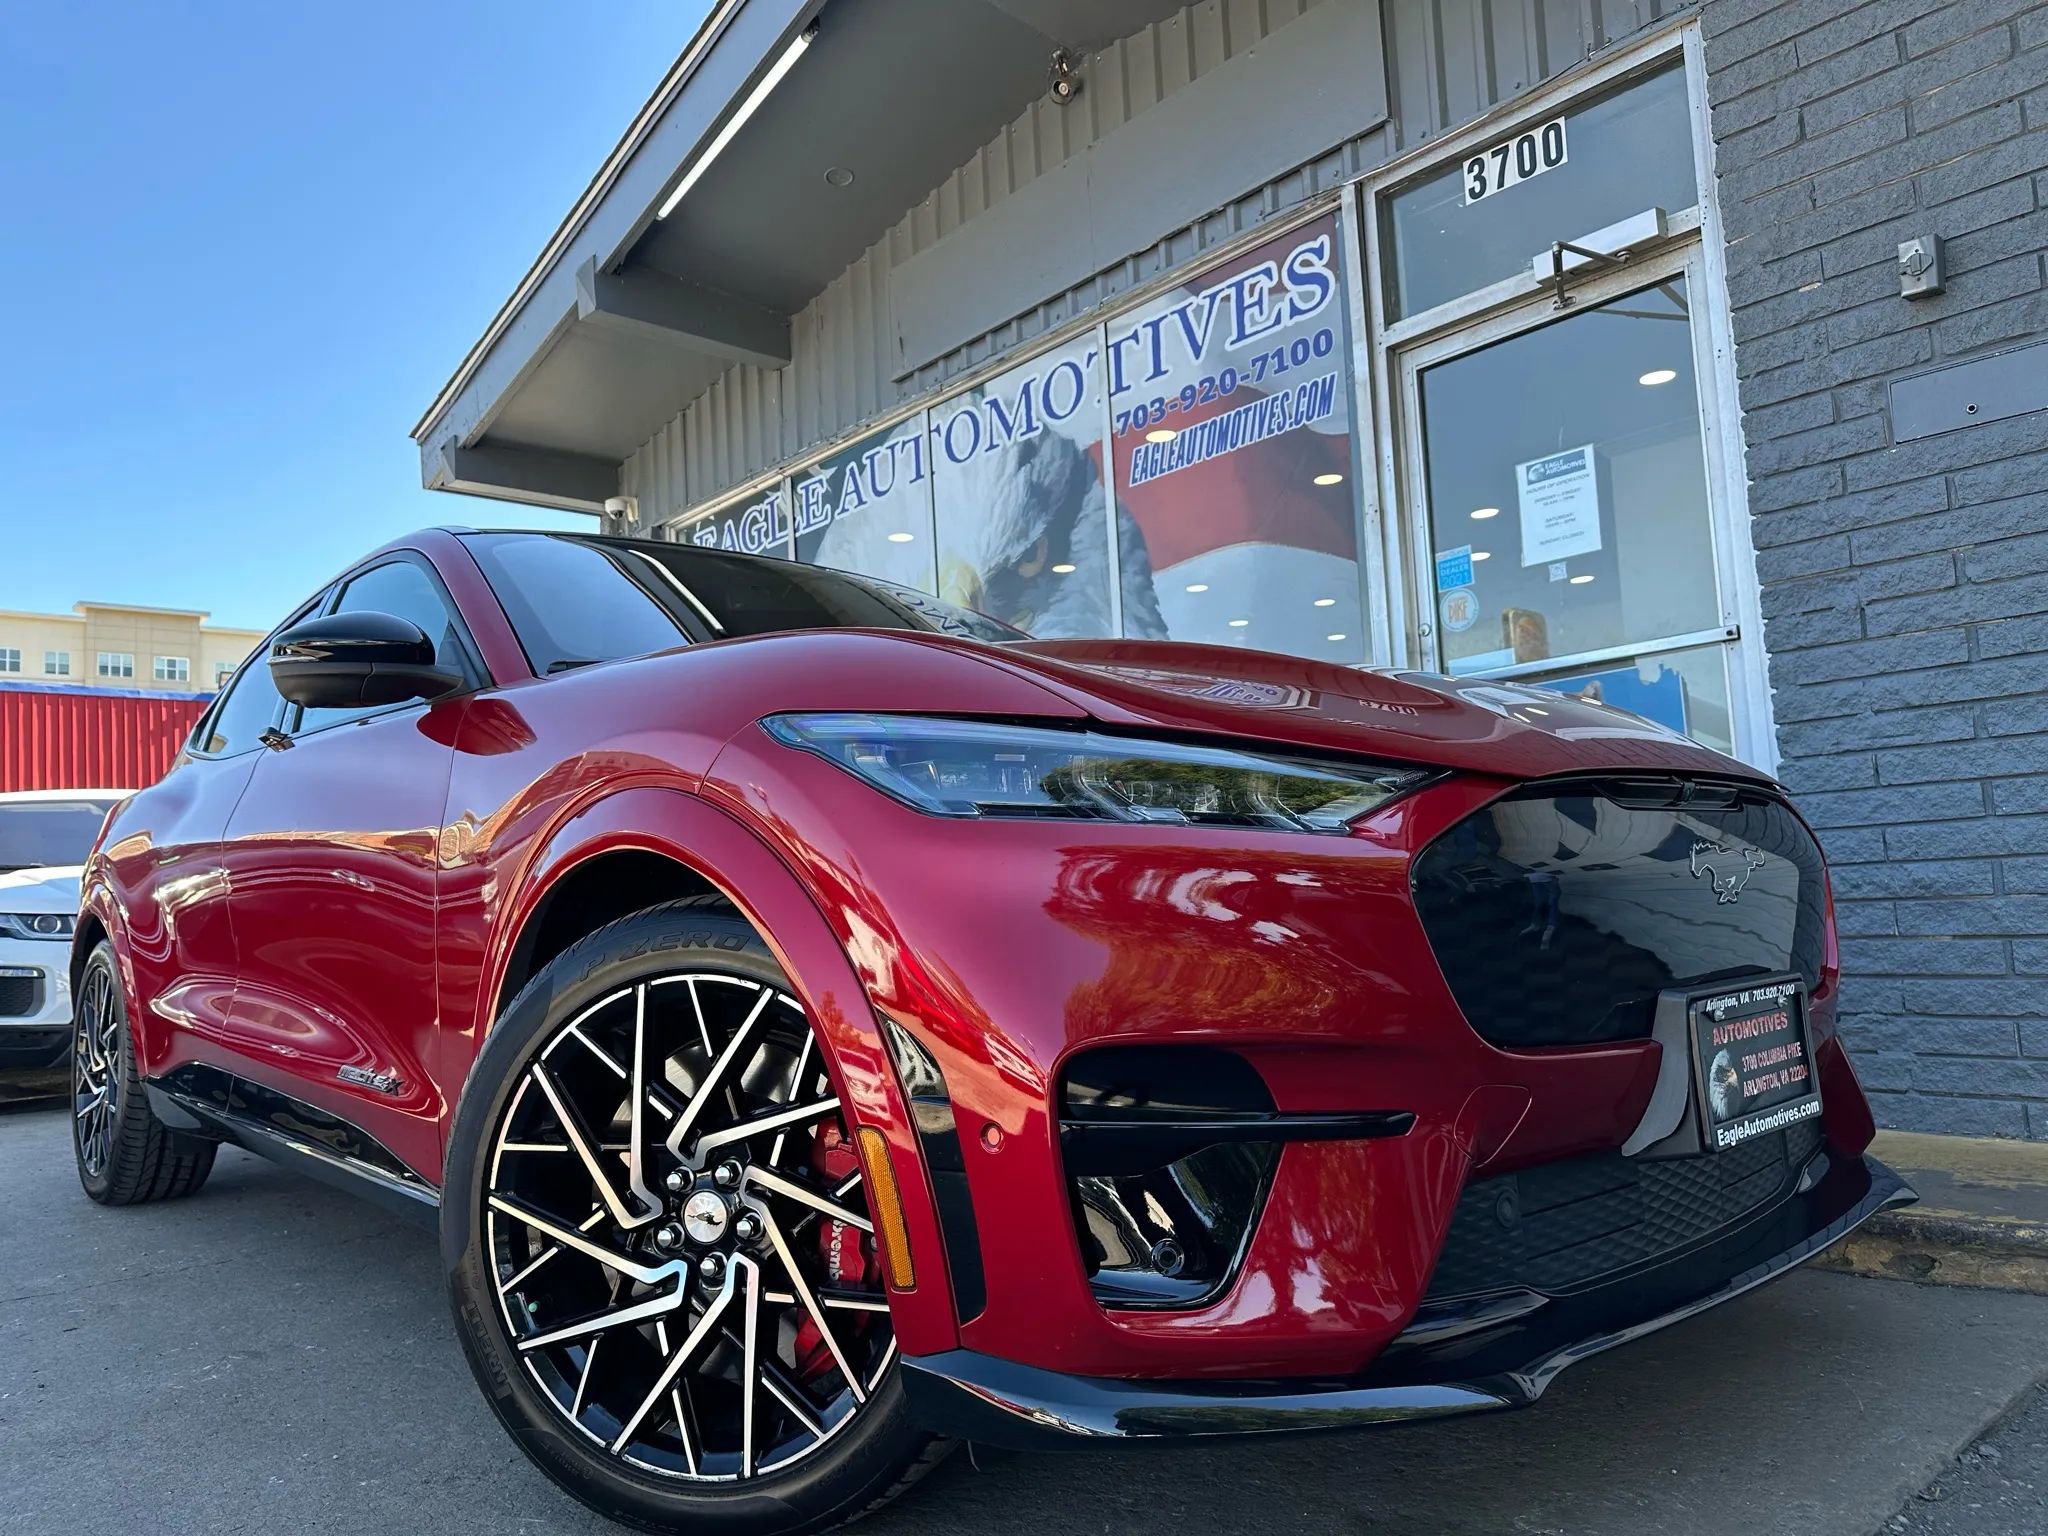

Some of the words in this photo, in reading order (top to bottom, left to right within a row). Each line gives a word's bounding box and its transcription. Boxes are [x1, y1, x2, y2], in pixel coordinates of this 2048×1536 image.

[1467, 122, 1563, 200] 3700
[692, 474, 832, 555] EAGLE
[836, 233, 1336, 516] AUTOMOTIVES
[1115, 327, 1335, 437] 703-920-7100
[1128, 371, 1337, 487] EAGLEAUTOMOTIVES.COM
[1544, 458, 1565, 470] EAGLE
[1440, 563, 1469, 577] DEALER
[580, 953, 605, 982] P
[618, 930, 750, 962] ZERO
[1740, 991, 1750, 1005] VA
[1712, 1011, 1788, 1046] AUTOMOTIVES
[1781, 1070, 1790, 1086] VA
[1717, 1099, 1820, 1147] EagleAutomotives.com
[828, 1218, 847, 1282] bremb
